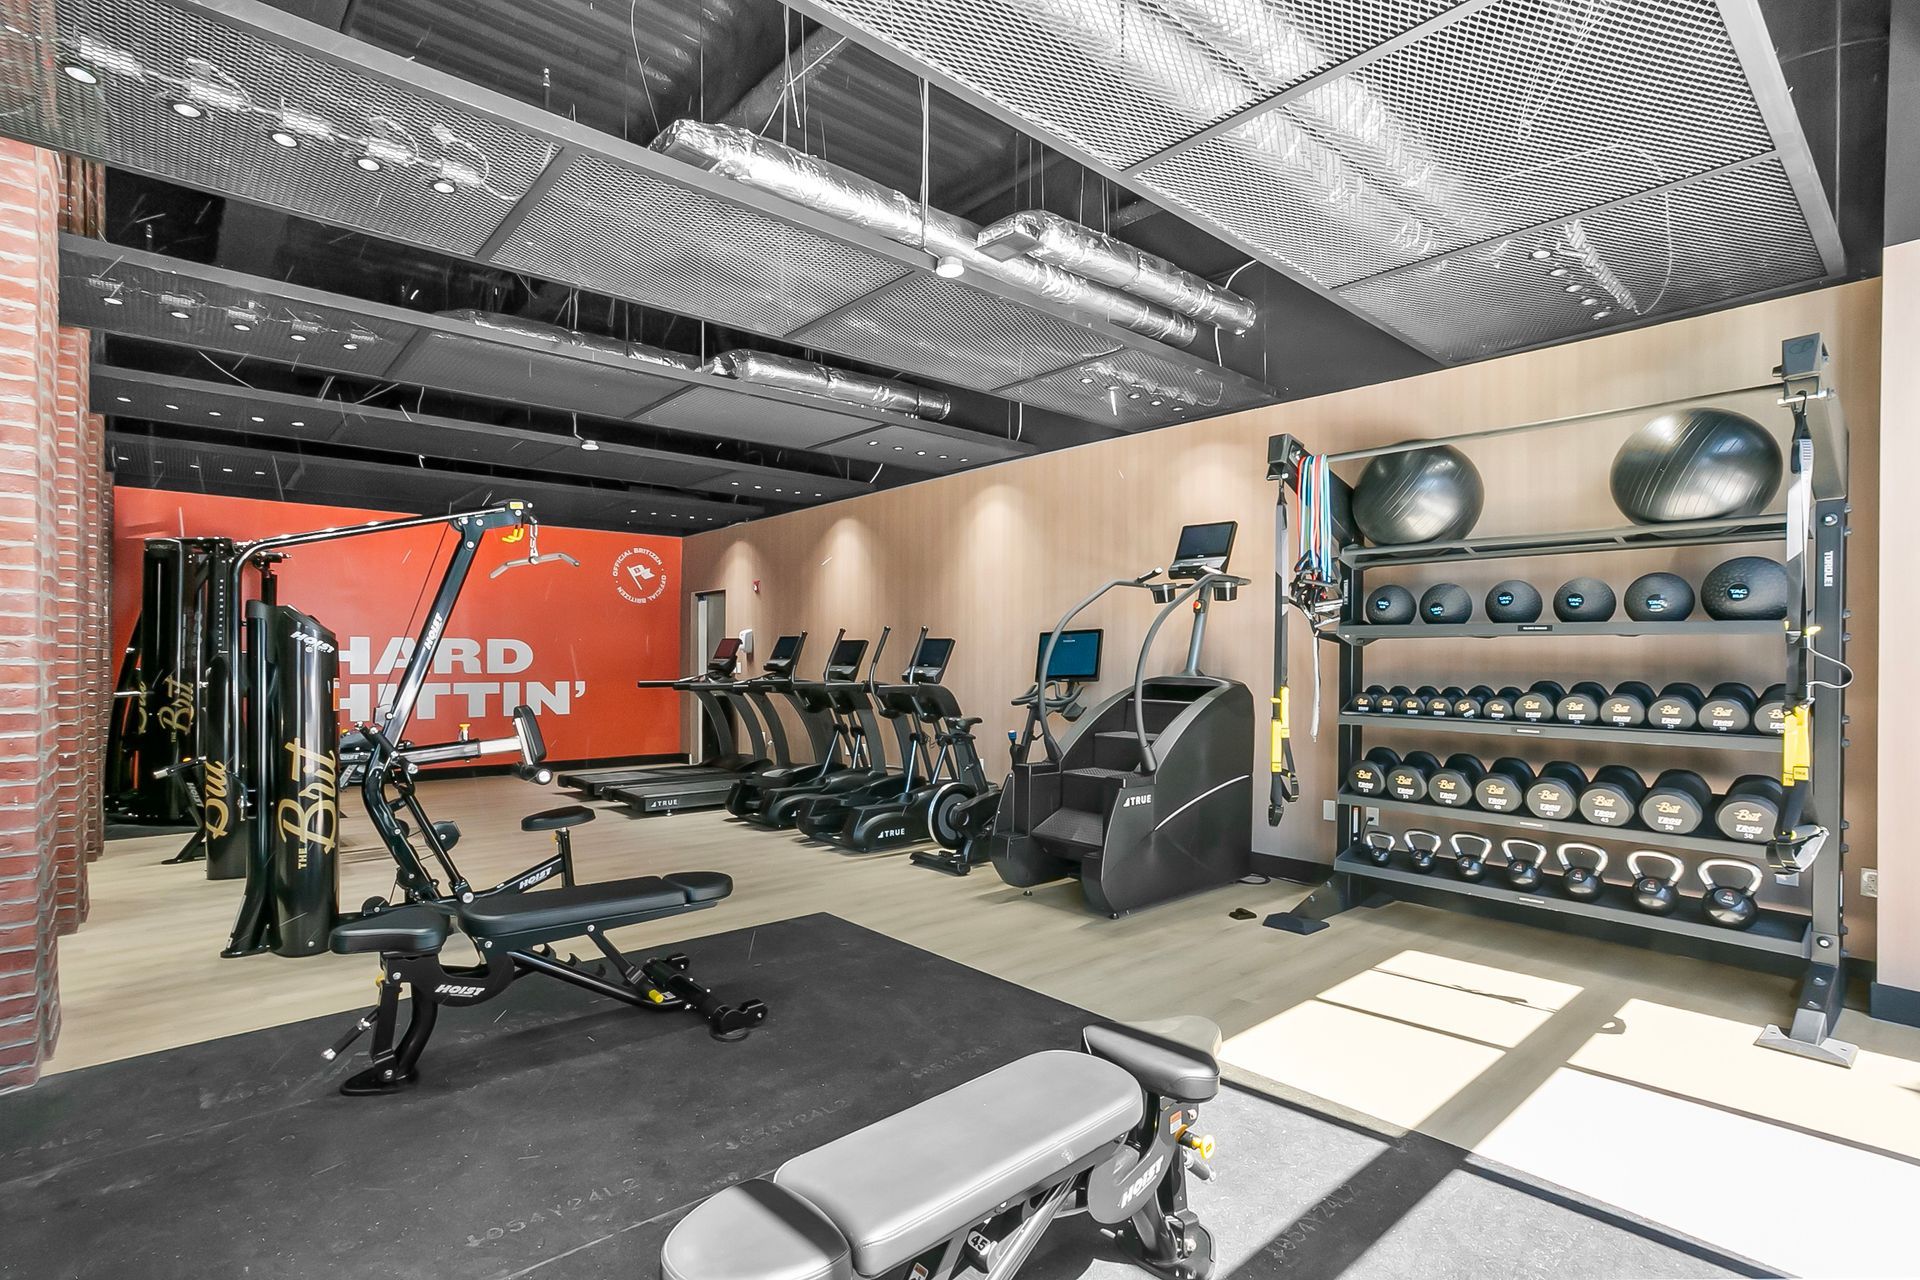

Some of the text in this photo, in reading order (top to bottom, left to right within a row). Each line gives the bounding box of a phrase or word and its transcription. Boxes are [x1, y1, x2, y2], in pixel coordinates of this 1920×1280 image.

[613, 547, 663, 577] OFFICIAL BRITIZEN
[290, 631, 335, 653] HOIST
[423, 611, 443, 651] HOIST
[339, 636, 534, 675] HARD
[278, 737, 336, 855] Brit
[657, 799, 678, 807] TRUE
[1130, 794, 1152, 806] TRUE
[1657, 816, 1682, 826] TROY
[1735, 824, 1763, 834] TROY
[884, 828, 905, 838] TRUE
[297, 847, 308, 870] THE
[518, 866, 553, 890] HOIST
[434, 984, 486, 996] HOIST
[1120, 1155, 1164, 1208] HOIST
[970, 1235, 988, 1251] 45
